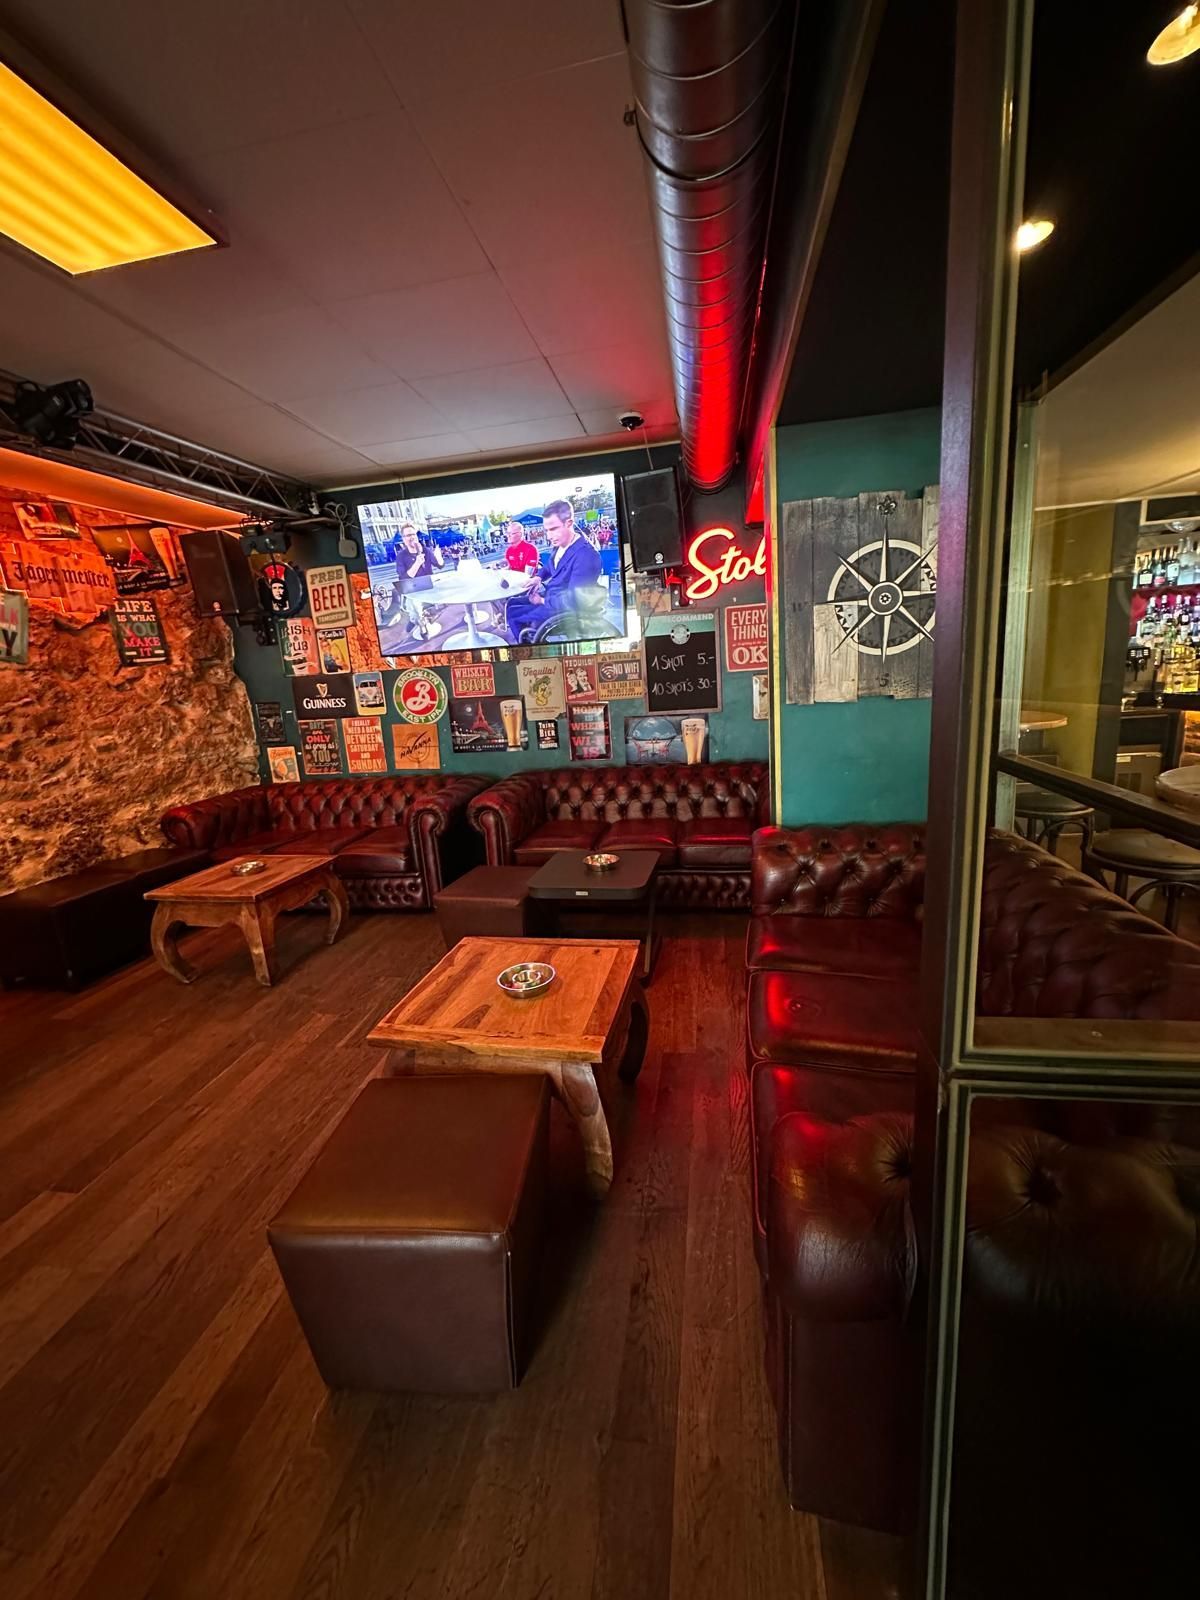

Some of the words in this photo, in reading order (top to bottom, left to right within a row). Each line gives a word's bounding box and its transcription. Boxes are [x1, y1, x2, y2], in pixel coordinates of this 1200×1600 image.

[310, 568, 344, 585] FREE
[312, 583, 347, 613] BEER
[115, 600, 153, 613] LIFE
[116, 614, 127, 622] IS
[129, 614, 156, 622] WHAT
[732, 609, 768, 626] EVERY
[119, 622, 159, 637] YOU
[281, 625, 312, 639] IRISH
[733, 624, 768, 641] THING
[123, 637, 161, 648] MAKE
[284, 641, 309, 656] PUB
[140, 648, 152, 656] IT
[652, 656, 660, 670] 1
[661, 654, 686, 671] SHOT
[454, 666, 489, 678] WHISKEY
[522, 665, 556, 678] Tequila!
[398, 670, 440, 688] BROOKLYN
[458, 678, 491, 692] BAR
[652, 682, 665, 696] 10
[303, 698, 347, 710] GUINNESS
[402, 709, 426, 724] EAST
[428, 709, 442, 721] IPA
[306, 735, 330, 743] ONLY
[346, 734, 382, 745] BETWEEN
[312, 750, 331, 763] YOU
[351, 759, 382, 770] SUNDAY
